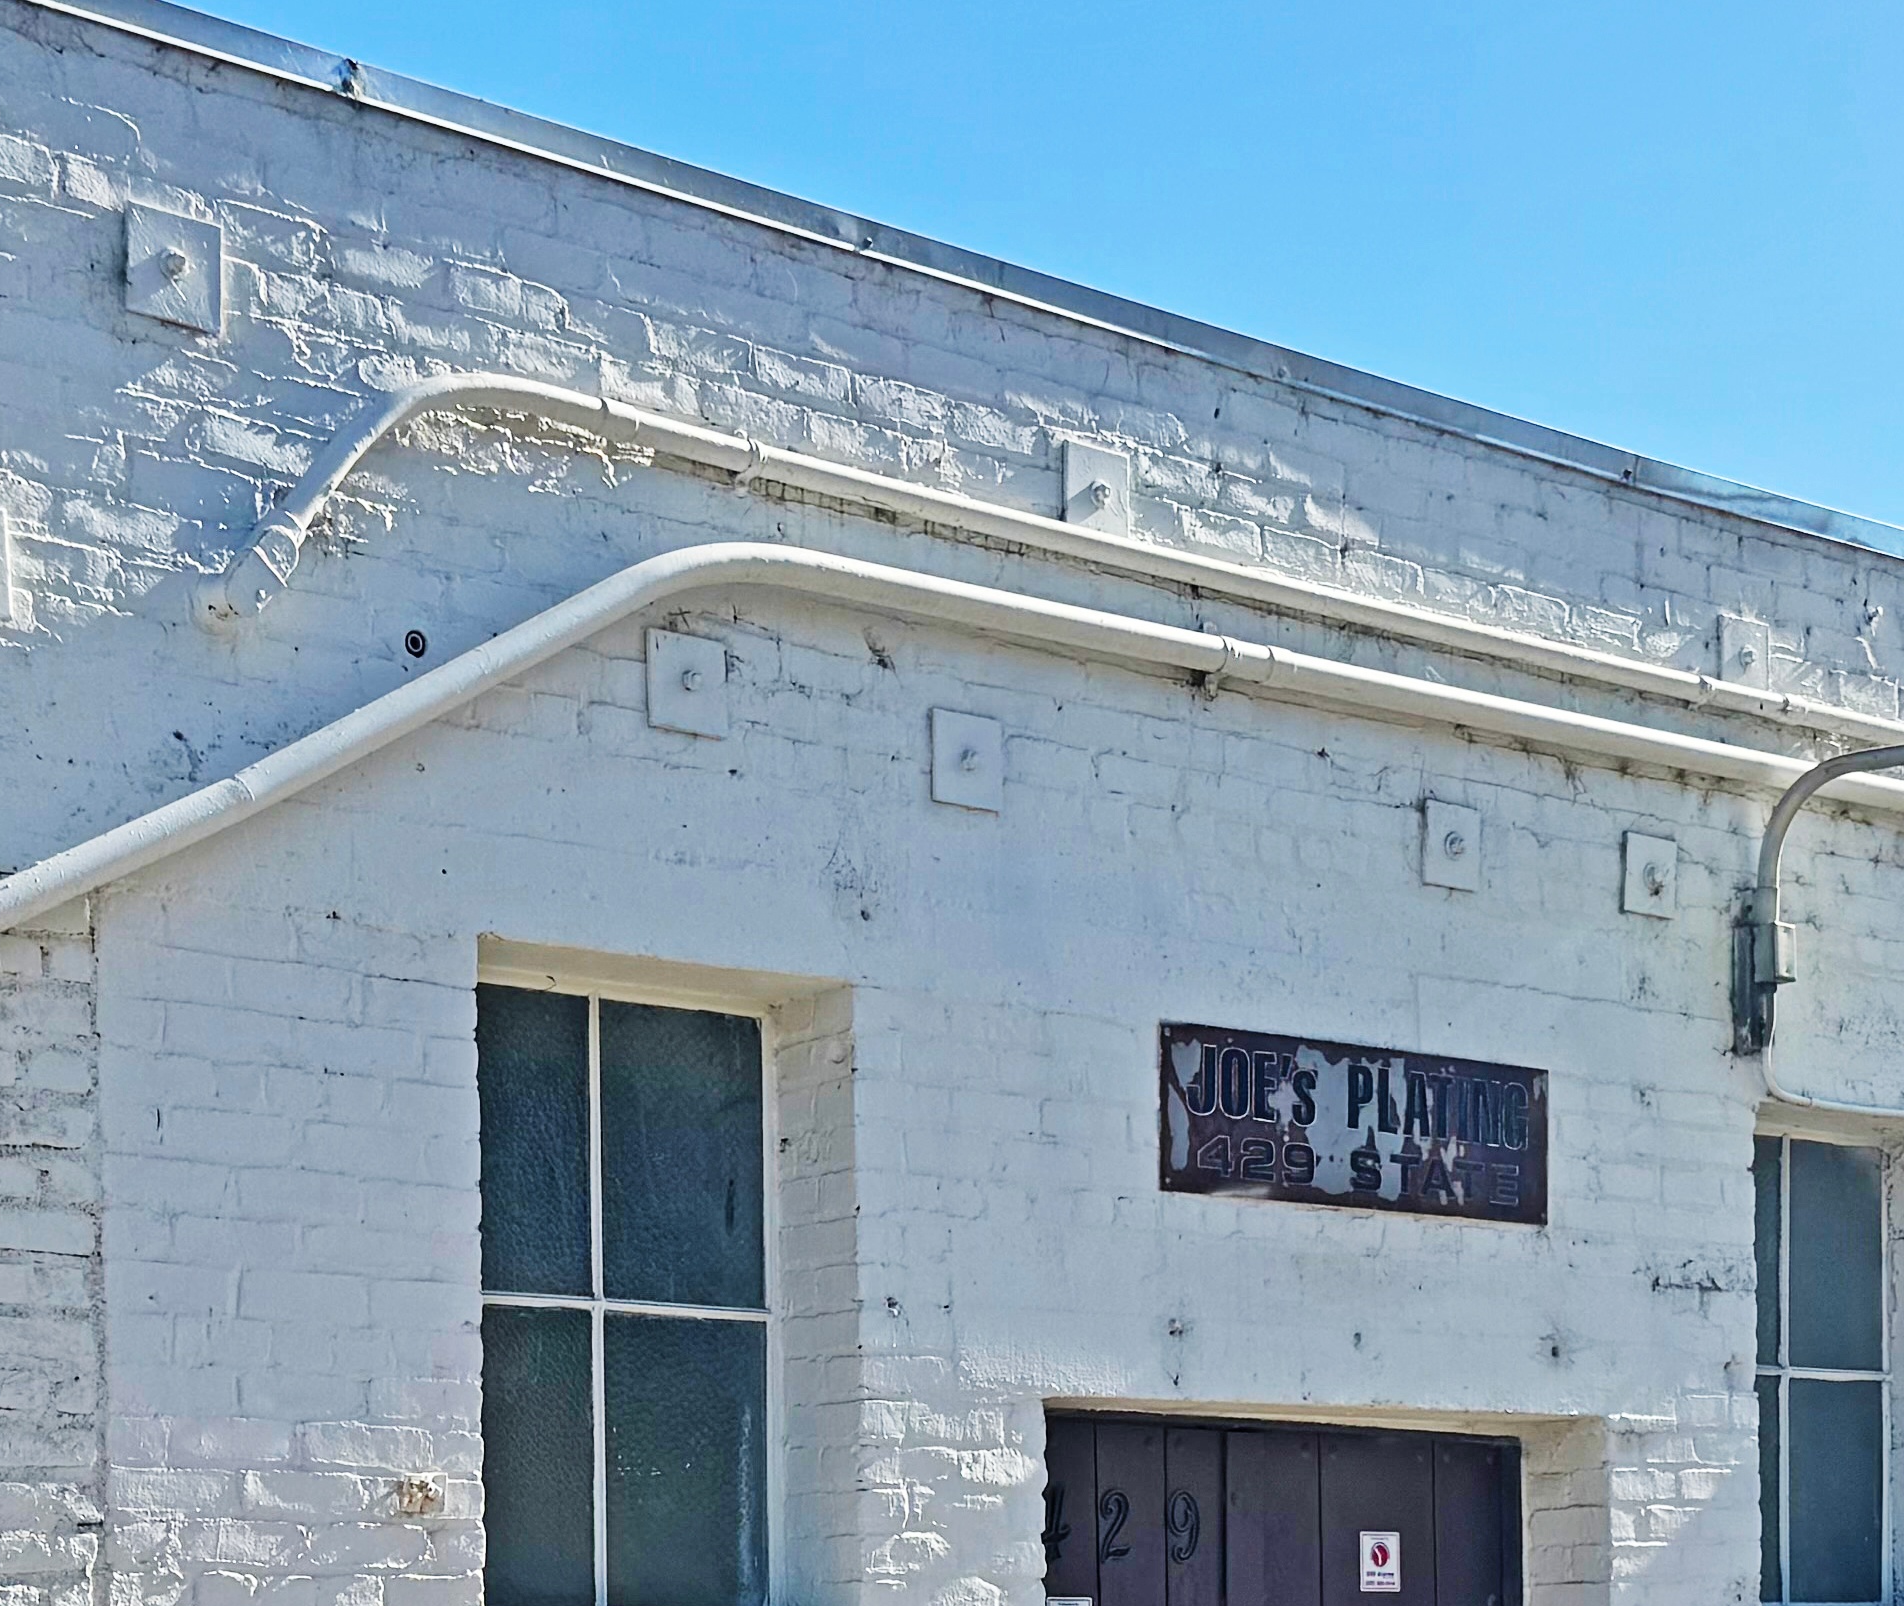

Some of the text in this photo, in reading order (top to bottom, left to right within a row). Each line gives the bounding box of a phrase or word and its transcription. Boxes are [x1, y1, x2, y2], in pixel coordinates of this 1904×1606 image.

[1347, 1062, 1529, 1150] PLATING
[1197, 1134, 1520, 1207] 429 STATE
